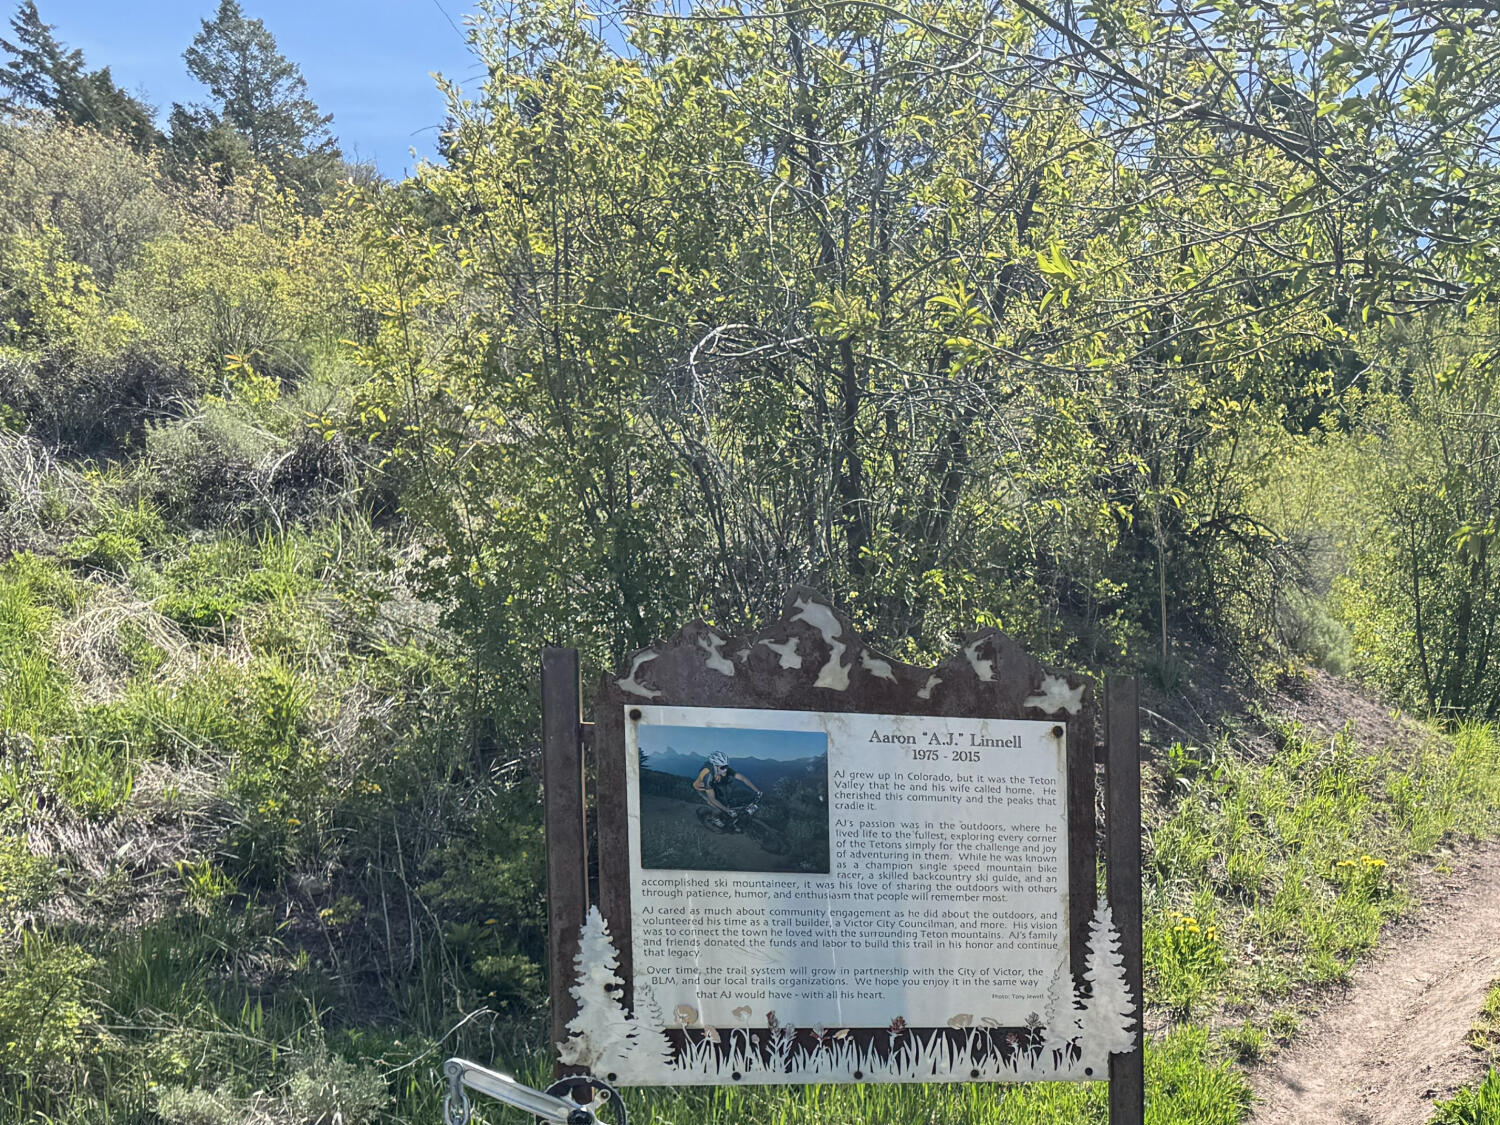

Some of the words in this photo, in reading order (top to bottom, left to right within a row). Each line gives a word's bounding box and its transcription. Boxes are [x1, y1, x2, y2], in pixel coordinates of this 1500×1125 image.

[868, 730, 916, 744] Aaron
[922, 732, 963, 746] "A.J."
[970, 733, 1021, 748] Linnell
[912, 749, 938, 761] 1975
[951, 750, 980, 761] 2015
[833, 770, 845, 779] AJ
[849, 773, 874, 782] grew
[877, 773, 890, 782] up
[894, 772, 903, 781] in
[907, 772, 953, 784] Colorado,
[956, 774, 973, 783] but
[976, 774, 984, 783] it
[987, 776, 1006, 784] was
[1009, 775, 1025, 784] the
[1028, 775, 1056, 785] Teton
[834, 780, 864, 792] Valley
[868, 781, 889, 790] that
[893, 782, 905, 791] he
[909, 782, 927, 791] and
[931, 783, 945, 792] his
[949, 783, 970, 792] wife
[973, 784, 1001, 793] called
[1005, 785, 1034, 794] home.
[1042, 786, 1056, 795] He
[641, 906, 654, 915] AJ
[657, 906, 685, 915] cared
[703, 907, 732, 916] much
[735, 907, 765, 916] about
[769, 908, 826, 919] community
[829, 908, 890, 920] engagement
[907, 909, 919, 918] he
[923, 909, 938, 918] did
[941, 909, 969, 918] about
[973, 910, 989, 919] the
[992, 910, 1036, 921] outdoors,
[1040, 911, 1057, 919] and
